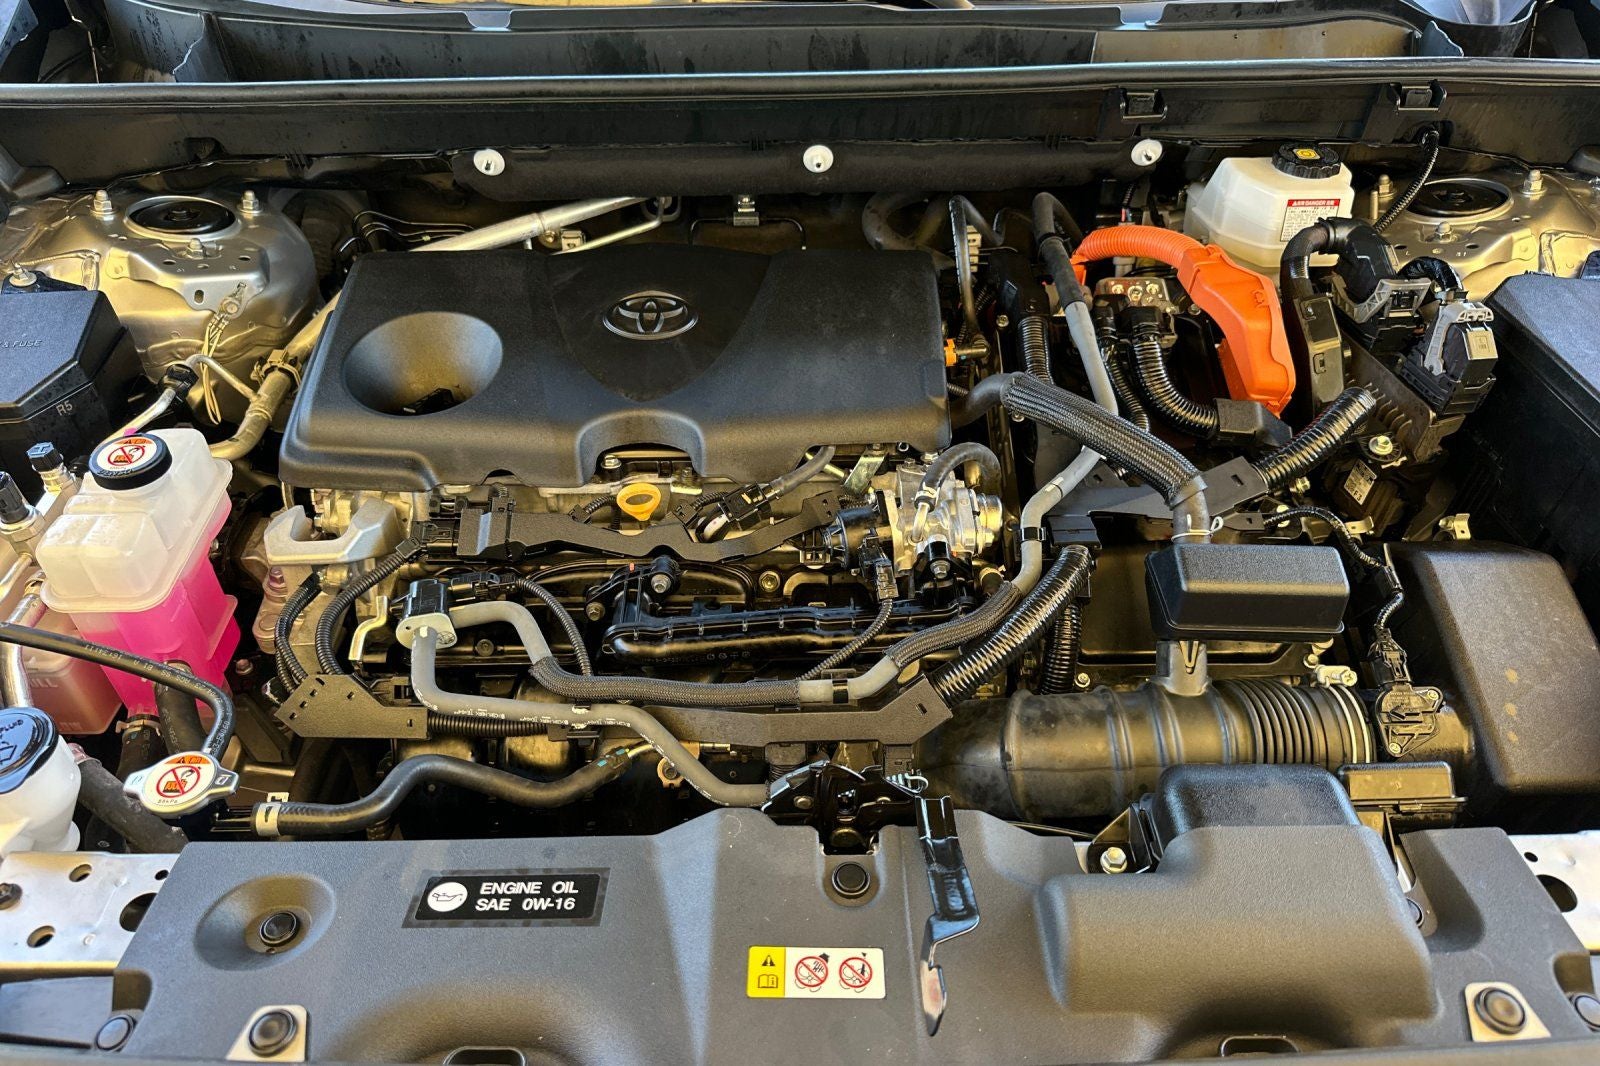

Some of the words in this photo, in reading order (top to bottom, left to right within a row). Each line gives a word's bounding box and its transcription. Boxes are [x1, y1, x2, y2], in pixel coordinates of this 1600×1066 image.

[12, 339, 43, 349] FUSE
[55, 400, 73, 416] R5
[480, 881, 543, 895] ENGINE
[551, 881, 579, 894] OIL
[475, 898, 511, 911] SAE
[521, 898, 576, 911] 0W-16
